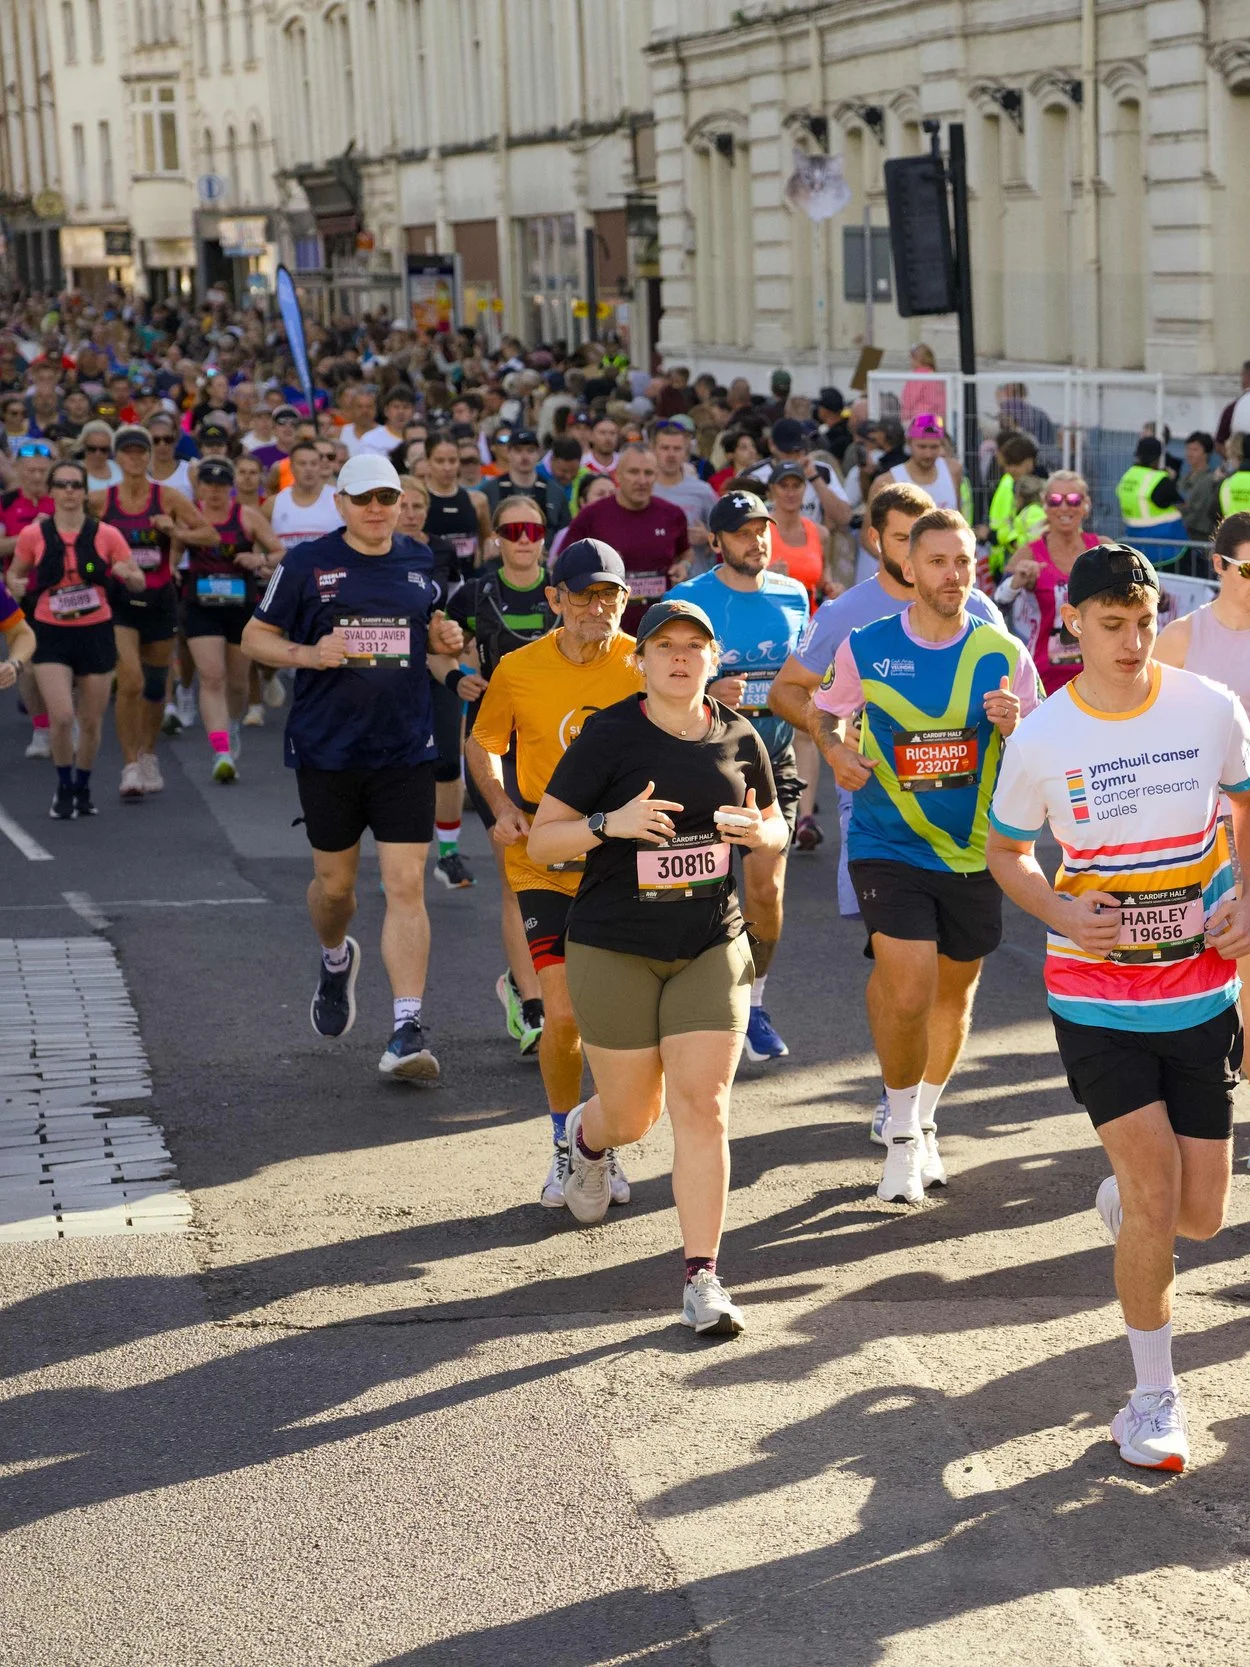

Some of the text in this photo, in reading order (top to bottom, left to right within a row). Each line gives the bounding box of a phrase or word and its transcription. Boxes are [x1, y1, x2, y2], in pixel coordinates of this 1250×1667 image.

[344, 630, 406, 641] SVALDO JAVIER
[357, 641, 388, 653] 3312
[922, 731, 947, 739] CARDIFF
[906, 745, 968, 760] RICHARD
[916, 759, 959, 774] 23207
[1089, 748, 1200, 778] ymchwil canser
[1091, 773, 1137, 792] cymru
[1094, 778, 1200, 806] cancer research
[1097, 803, 1138, 821] wales
[671, 832, 714, 843] CARDIFF HALF
[657, 851, 716, 879] 30816
[1139, 889, 1187, 901] CARDIFF HALF
[1121, 905, 1188, 926] HARLEY
[1130, 924, 1183, 943] 19656
